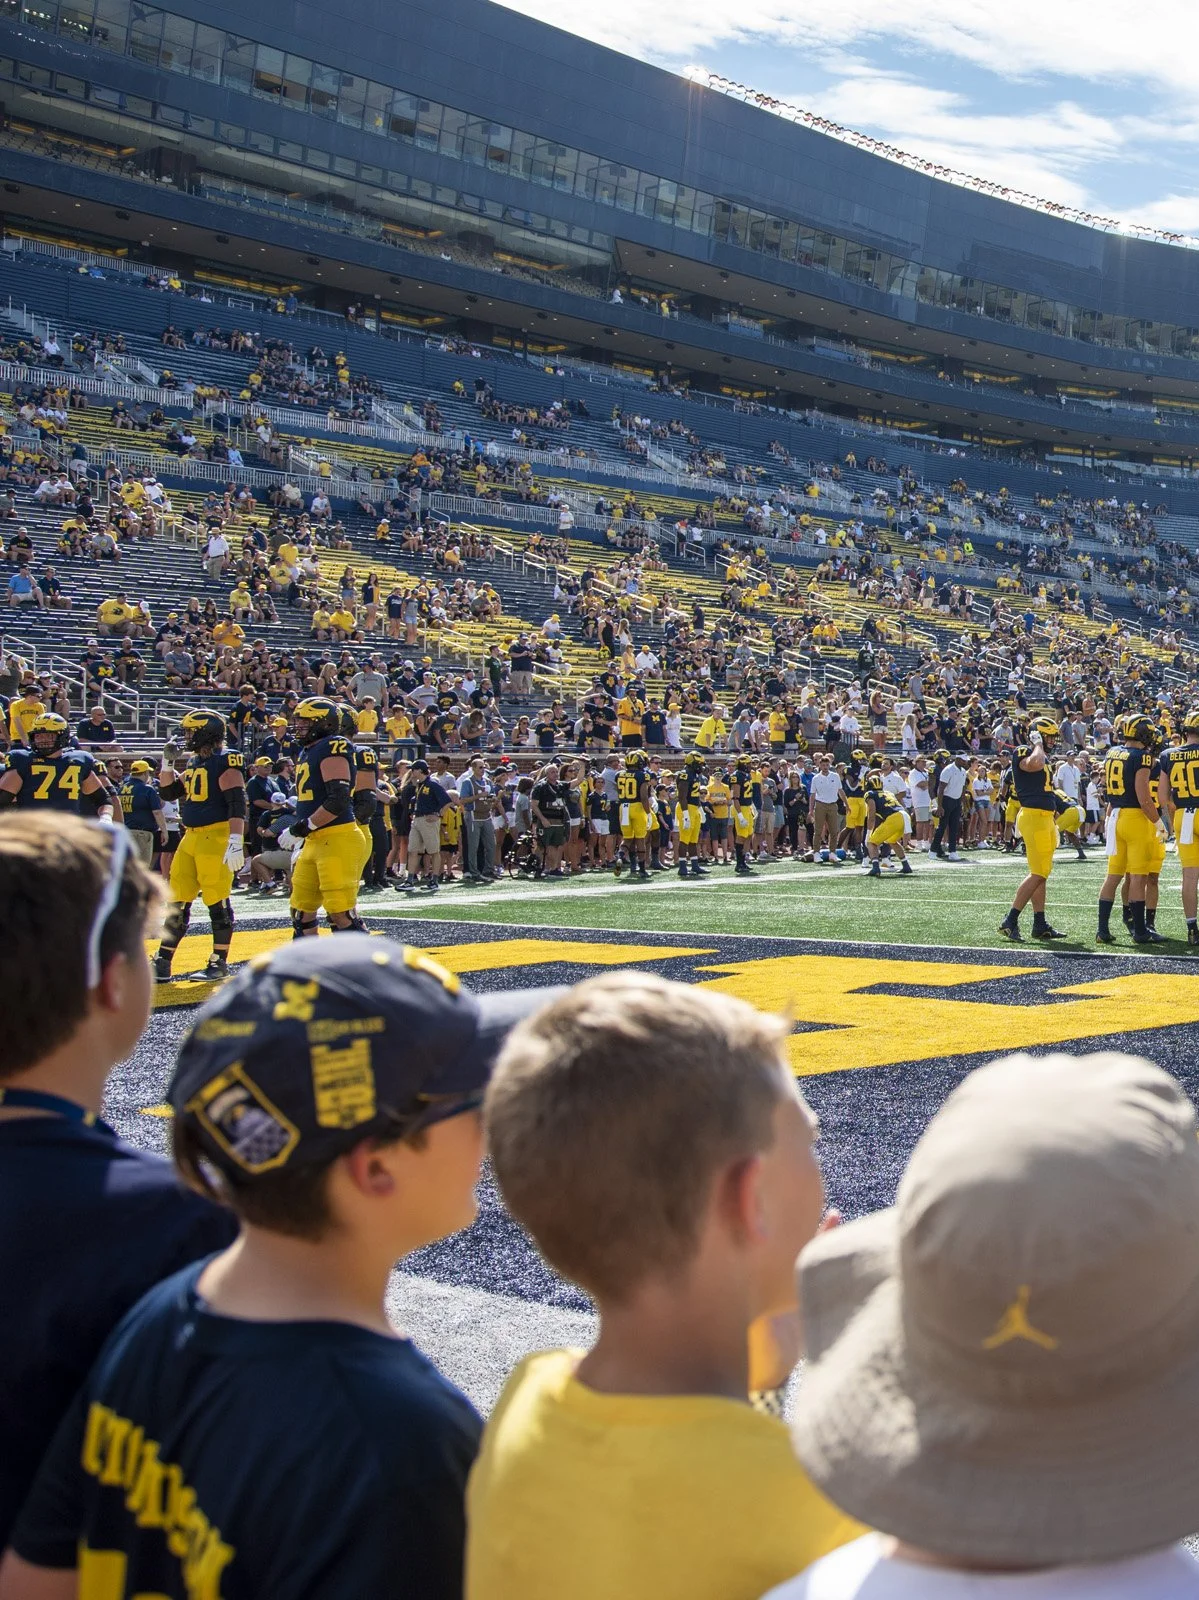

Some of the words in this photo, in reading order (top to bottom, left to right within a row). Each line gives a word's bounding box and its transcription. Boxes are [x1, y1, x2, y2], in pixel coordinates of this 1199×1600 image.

[329, 740, 348, 754] 72
[1017, 747, 1028, 757] 17
[228, 754, 243, 767] 60
[1142, 754, 1152, 766] 18
[31, 765, 82, 800] 74
[295, 762, 314, 801] 2
[1105, 759, 1125, 795] 18
[617, 778, 637, 799] 50
[118, 796, 133, 806] VENT
